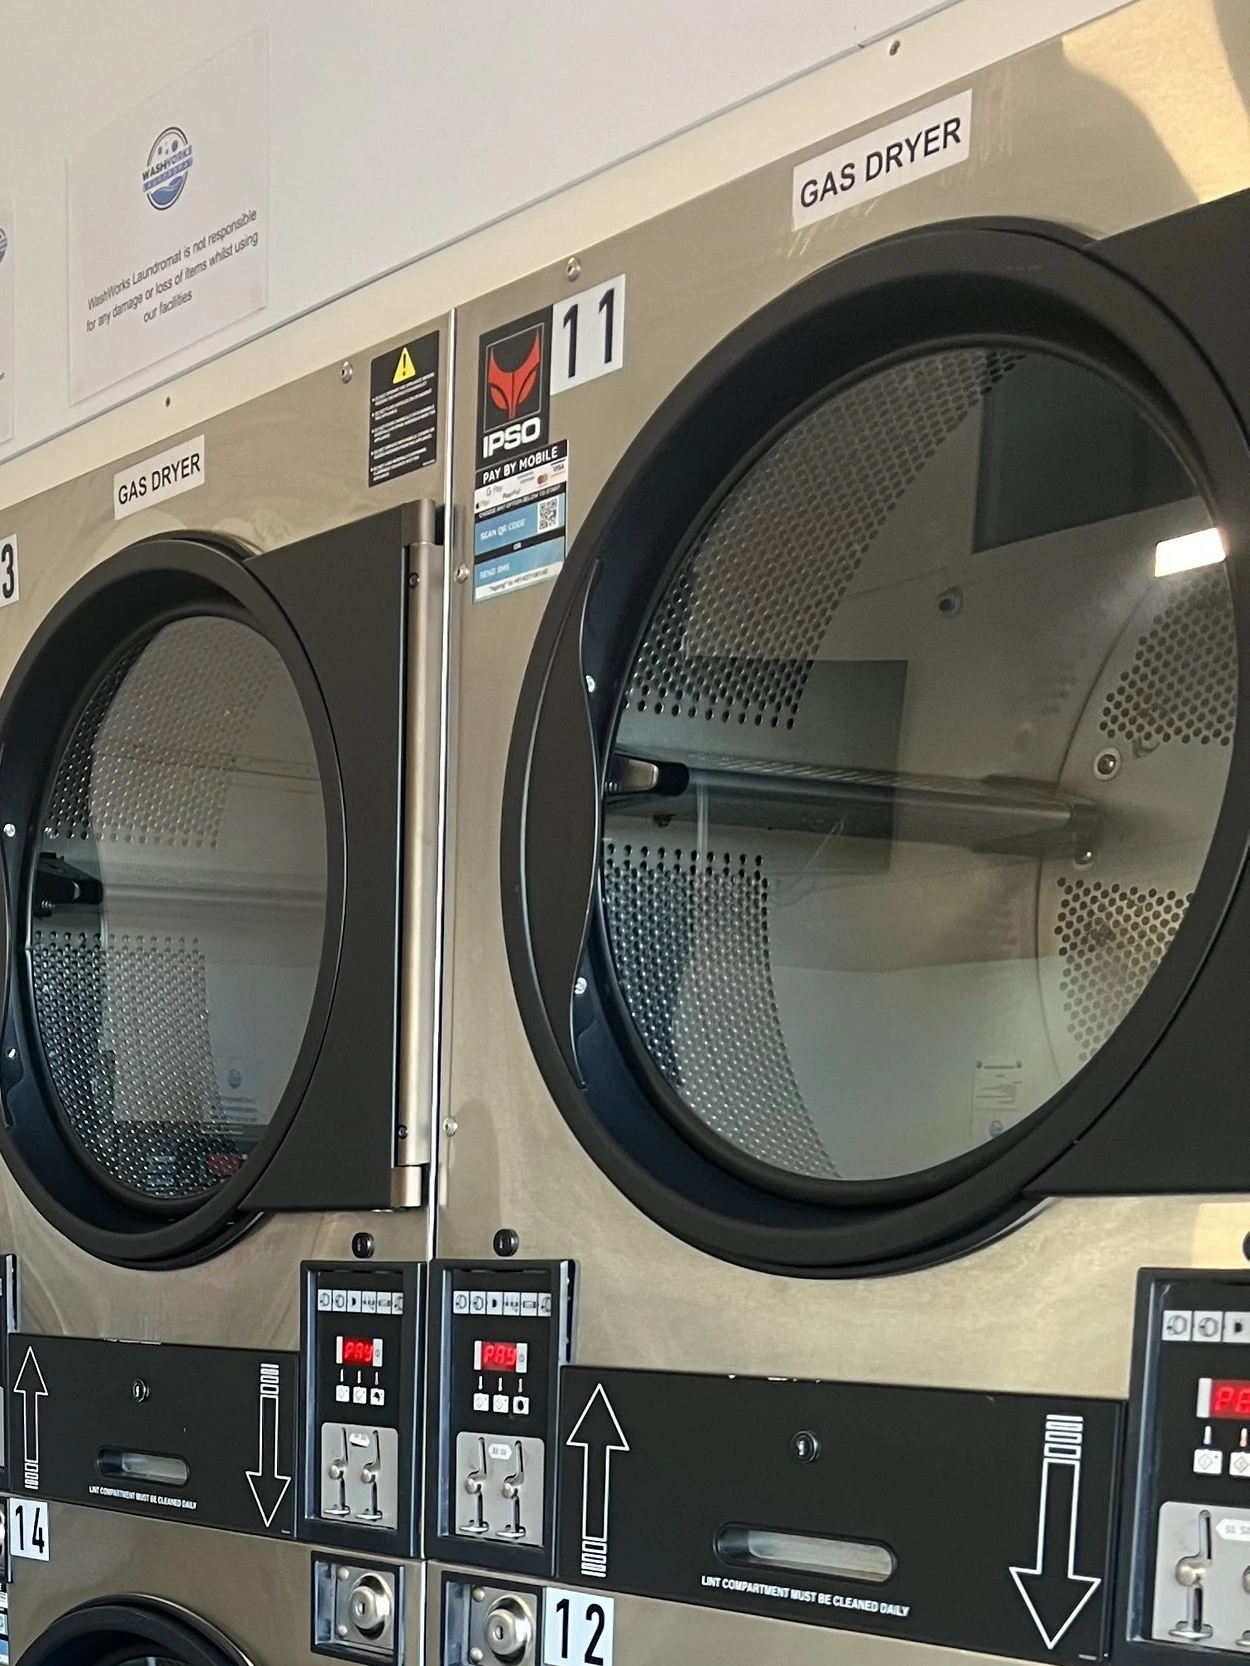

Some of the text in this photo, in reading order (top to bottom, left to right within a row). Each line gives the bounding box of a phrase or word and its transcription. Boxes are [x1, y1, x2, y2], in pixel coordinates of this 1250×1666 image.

[800, 117, 961, 208] GAS DRYER
[87, 210, 257, 310] WashWorks Laundromat is not responsible
[86, 232, 258, 332] for any damage or loss of items whilst using
[143, 290, 192, 323] our facilities
[563, 287, 615, 379] 11
[483, 417, 541, 459] IPSO
[118, 453, 200, 505] GAS DRYER
[483, 467, 501, 484] PAY
[504, 461, 517, 477] BY
[519, 446, 558, 470] MOBILE
[480, 518, 526, 541] SCAN QR CODE
[513, 542, 522, 551] OR
[479, 562, 510, 579] SEND SMS
[344, 1342, 374, 1362] PAY
[483, 1345, 517, 1366] PAY
[15, 1505, 44, 1553] 14
[701, 1575, 910, 1617] LINT COMPARTMENT MUST BE CLEANED DAILY
[556, 1598, 605, 1666] 12
